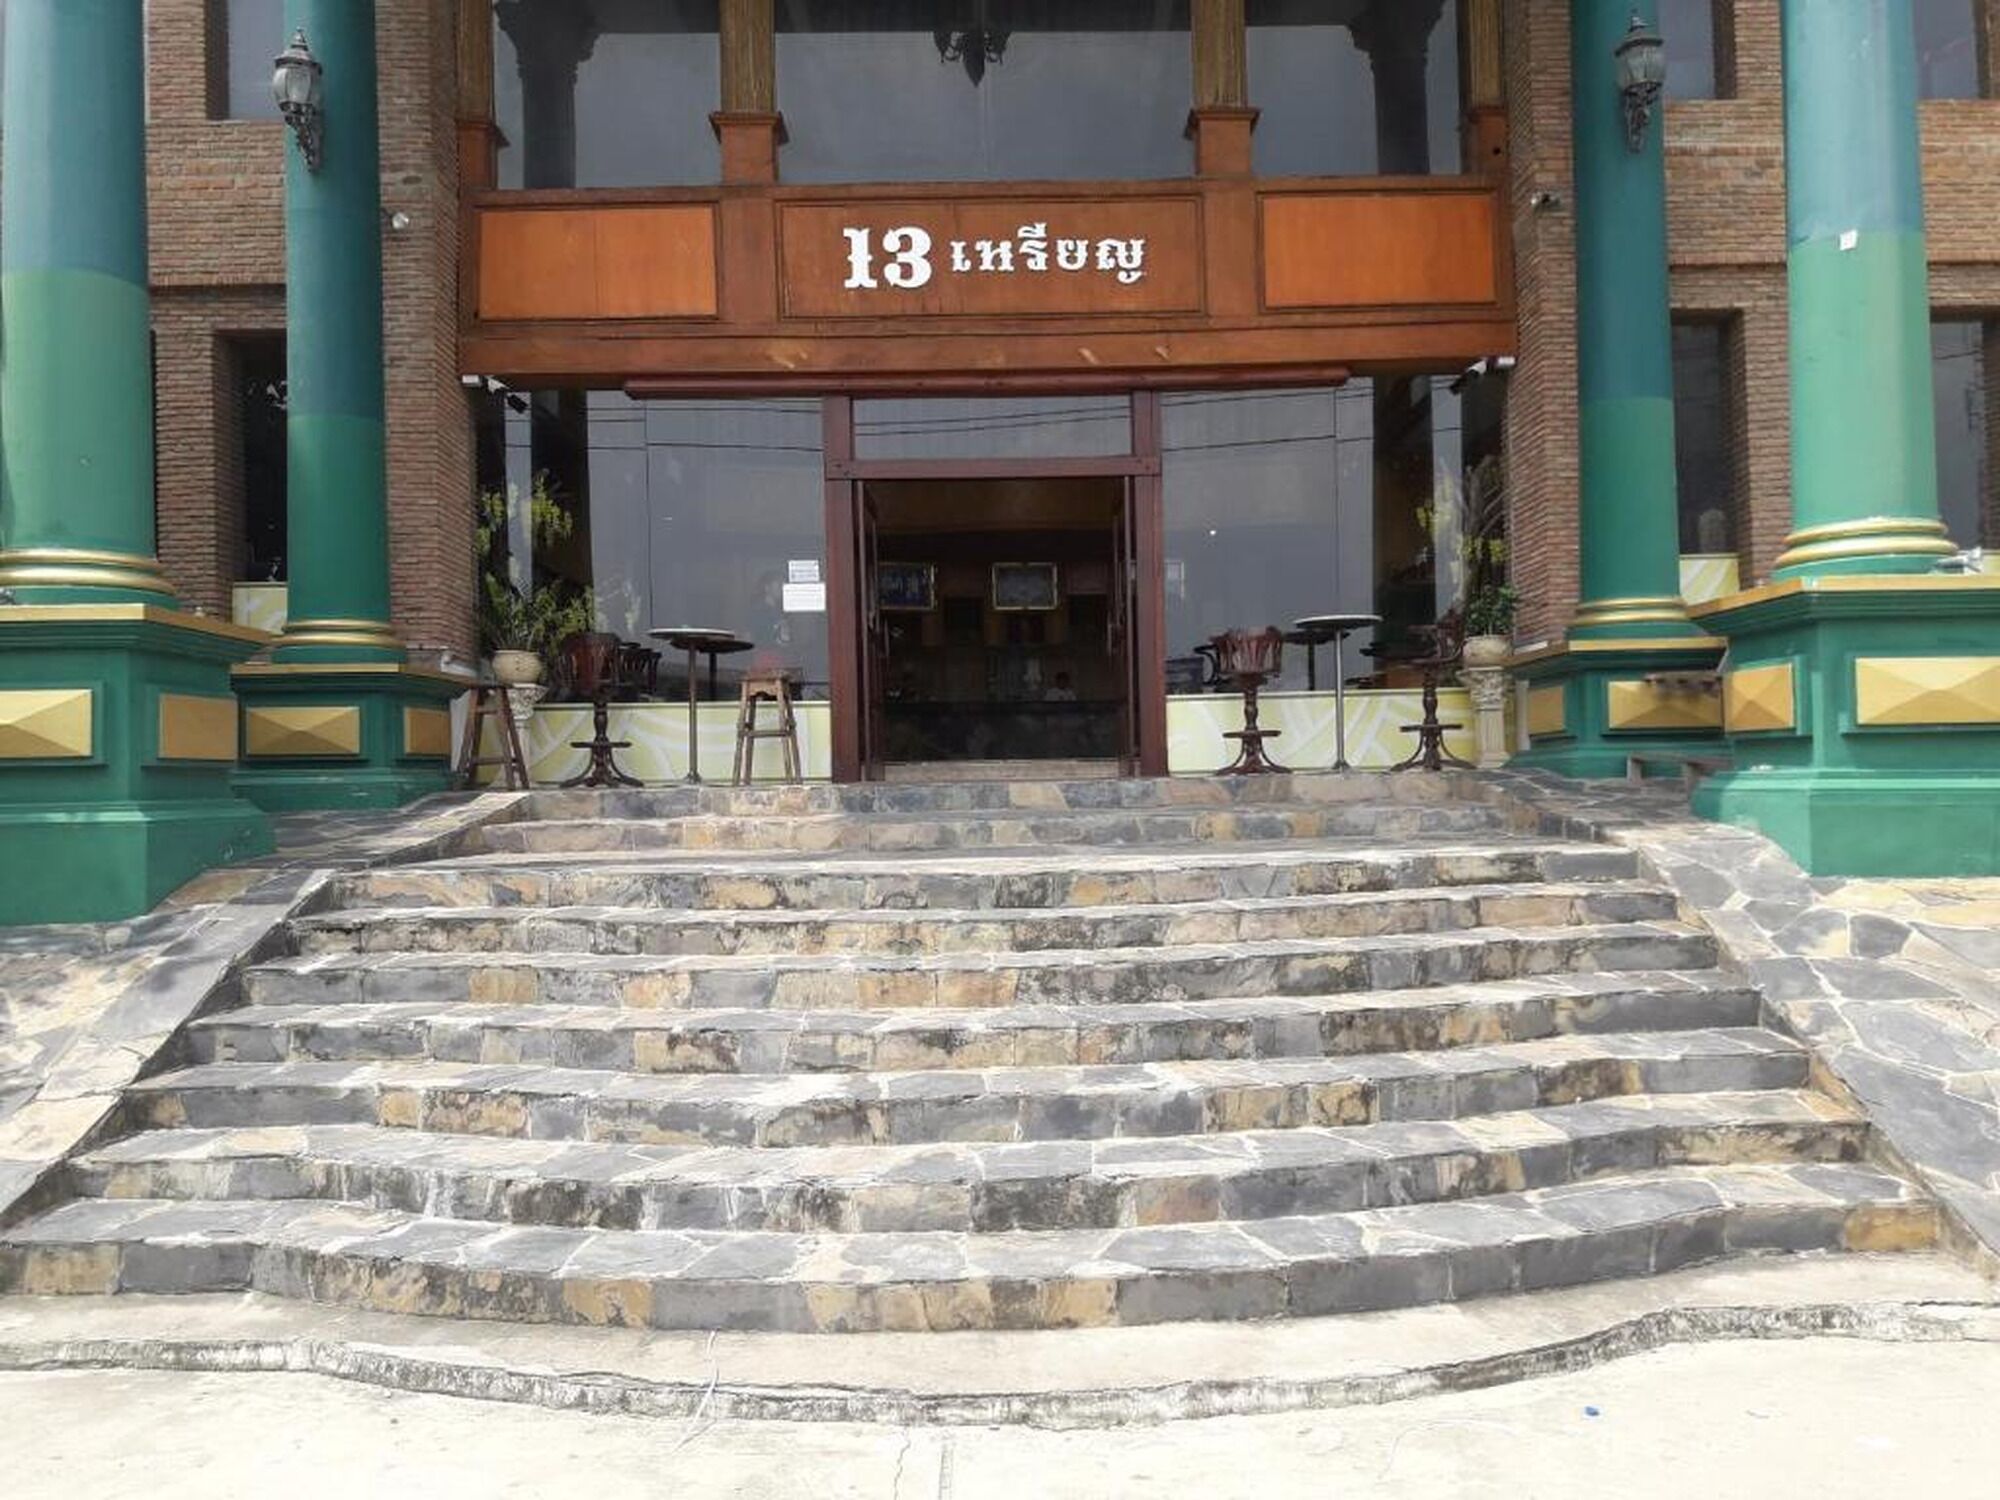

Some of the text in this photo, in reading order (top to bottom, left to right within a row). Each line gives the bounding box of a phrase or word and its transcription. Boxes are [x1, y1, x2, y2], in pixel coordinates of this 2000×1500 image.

[843, 222, 1145, 289] 13 เหรียญ
